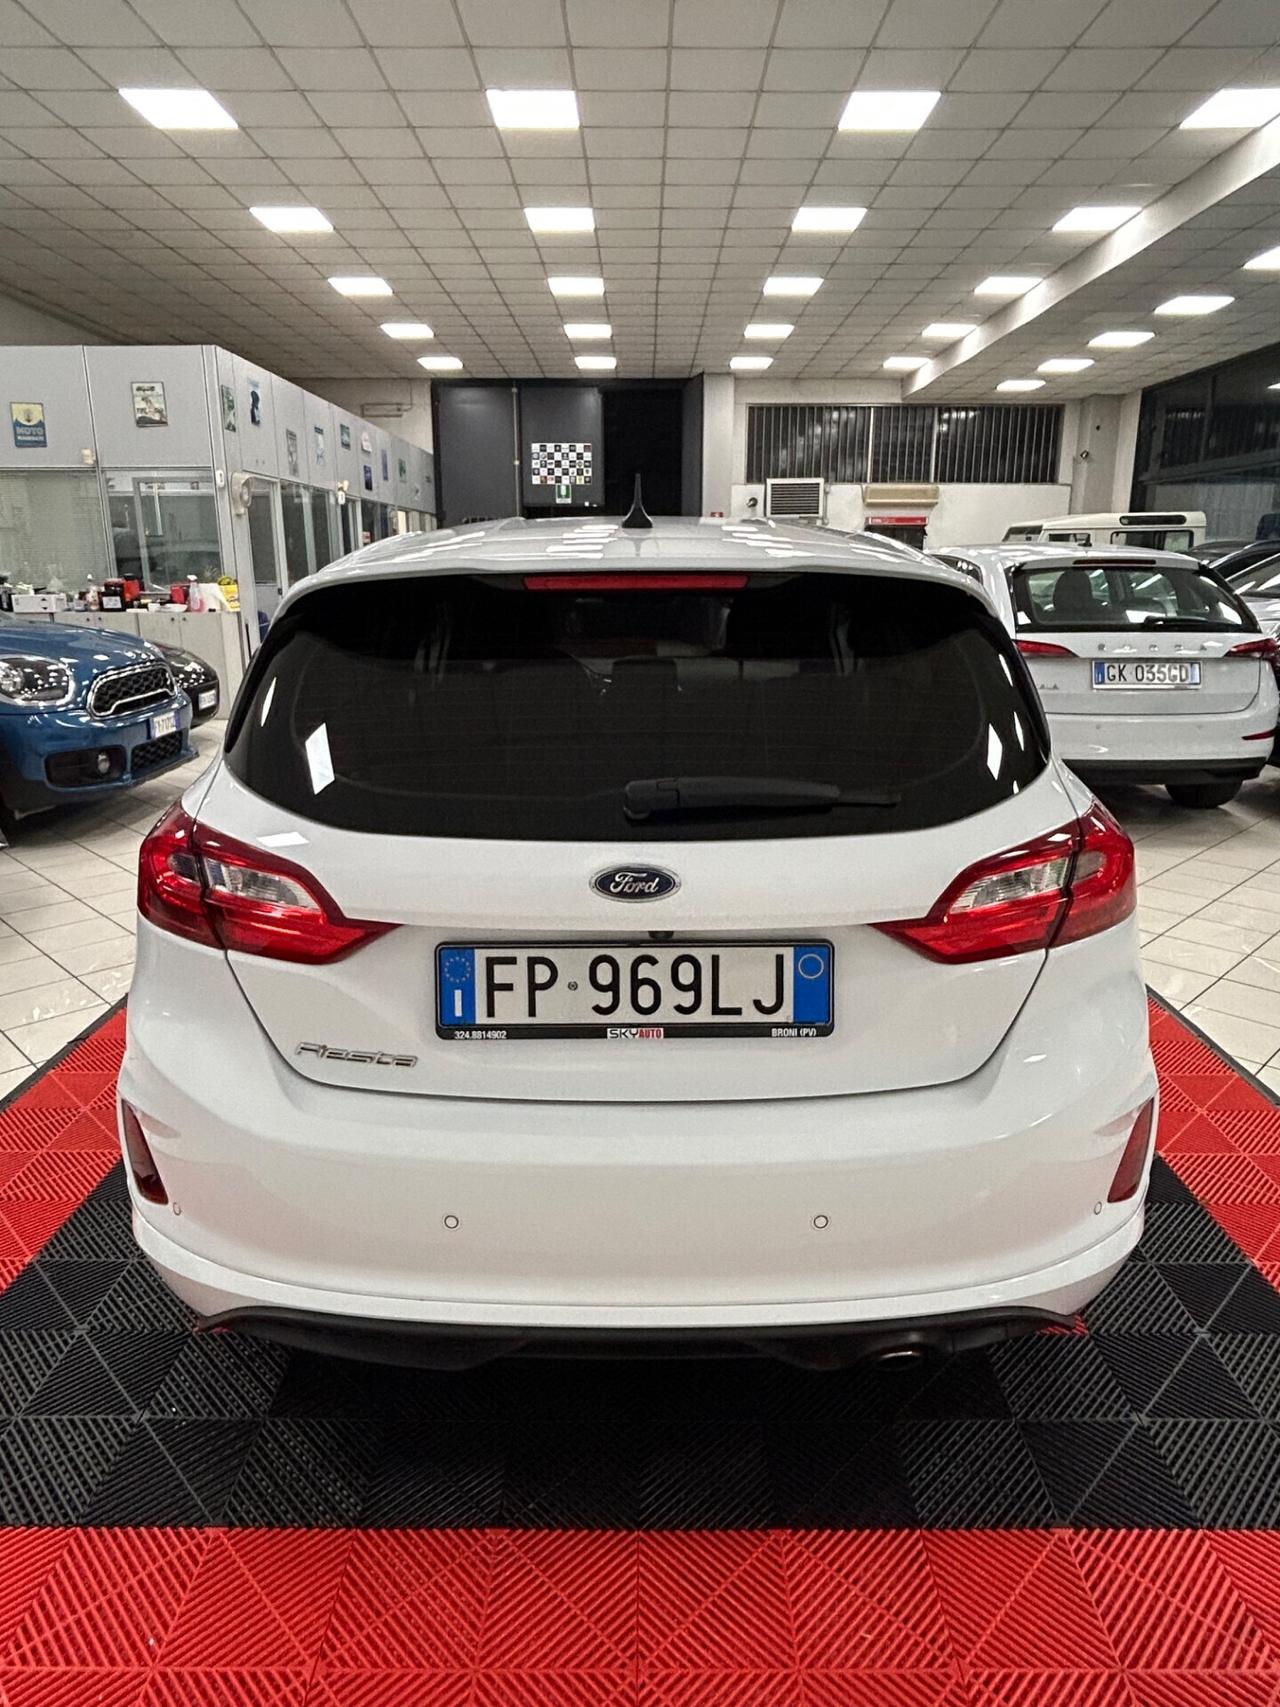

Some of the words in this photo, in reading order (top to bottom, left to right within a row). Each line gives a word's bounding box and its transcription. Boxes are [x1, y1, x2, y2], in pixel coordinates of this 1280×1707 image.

[1106, 664, 1128, 682] GK
[1135, 664, 1189, 682] 035GD
[609, 871, 660, 893] Ford
[485, 956, 559, 1018] FP
[588, 953, 785, 1016] 969LJ
[453, 1030, 508, 1040] 324.8814902
[771, 1027, 798, 1037] BRONI
[799, 1027, 817, 1037] (PV)
[295, 1041, 419, 1068] Fiesta
